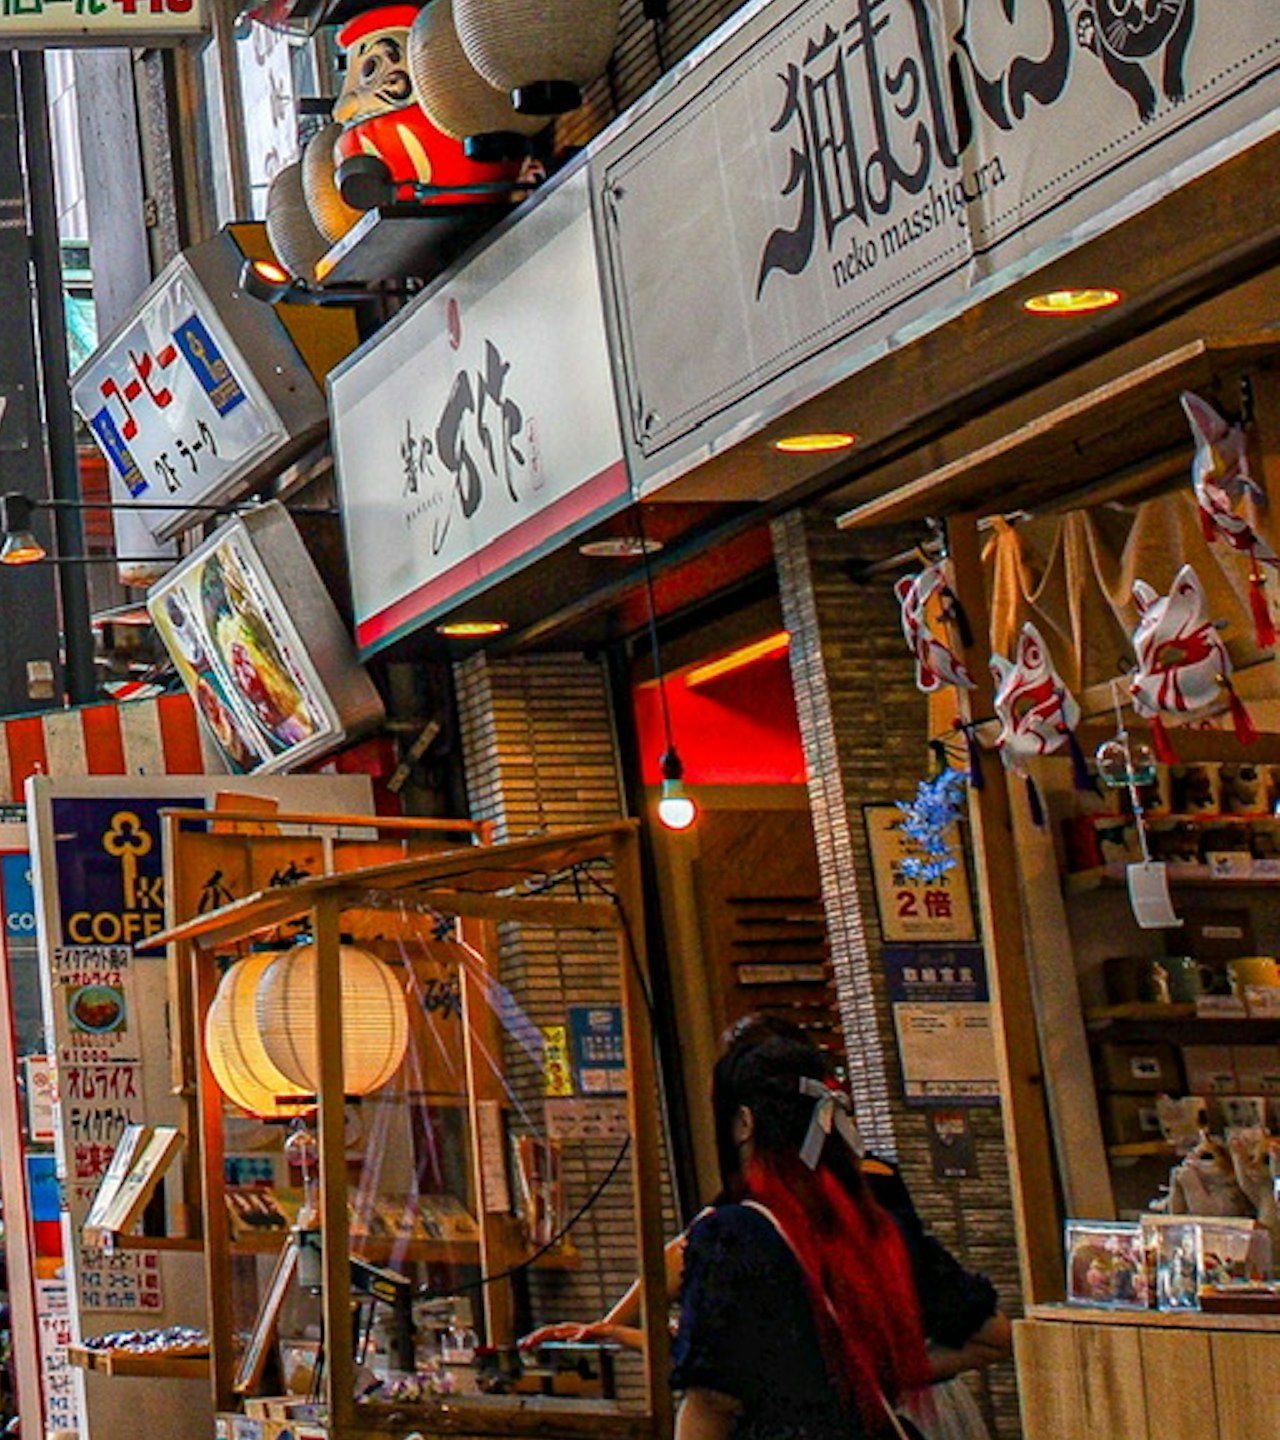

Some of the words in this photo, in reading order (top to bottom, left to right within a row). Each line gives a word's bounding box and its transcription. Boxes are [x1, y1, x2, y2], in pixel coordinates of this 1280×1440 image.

[831, 241, 879, 289] neko
[99, 343, 178, 442] コーヒー
[67, 1065, 137, 1100] オムライス
